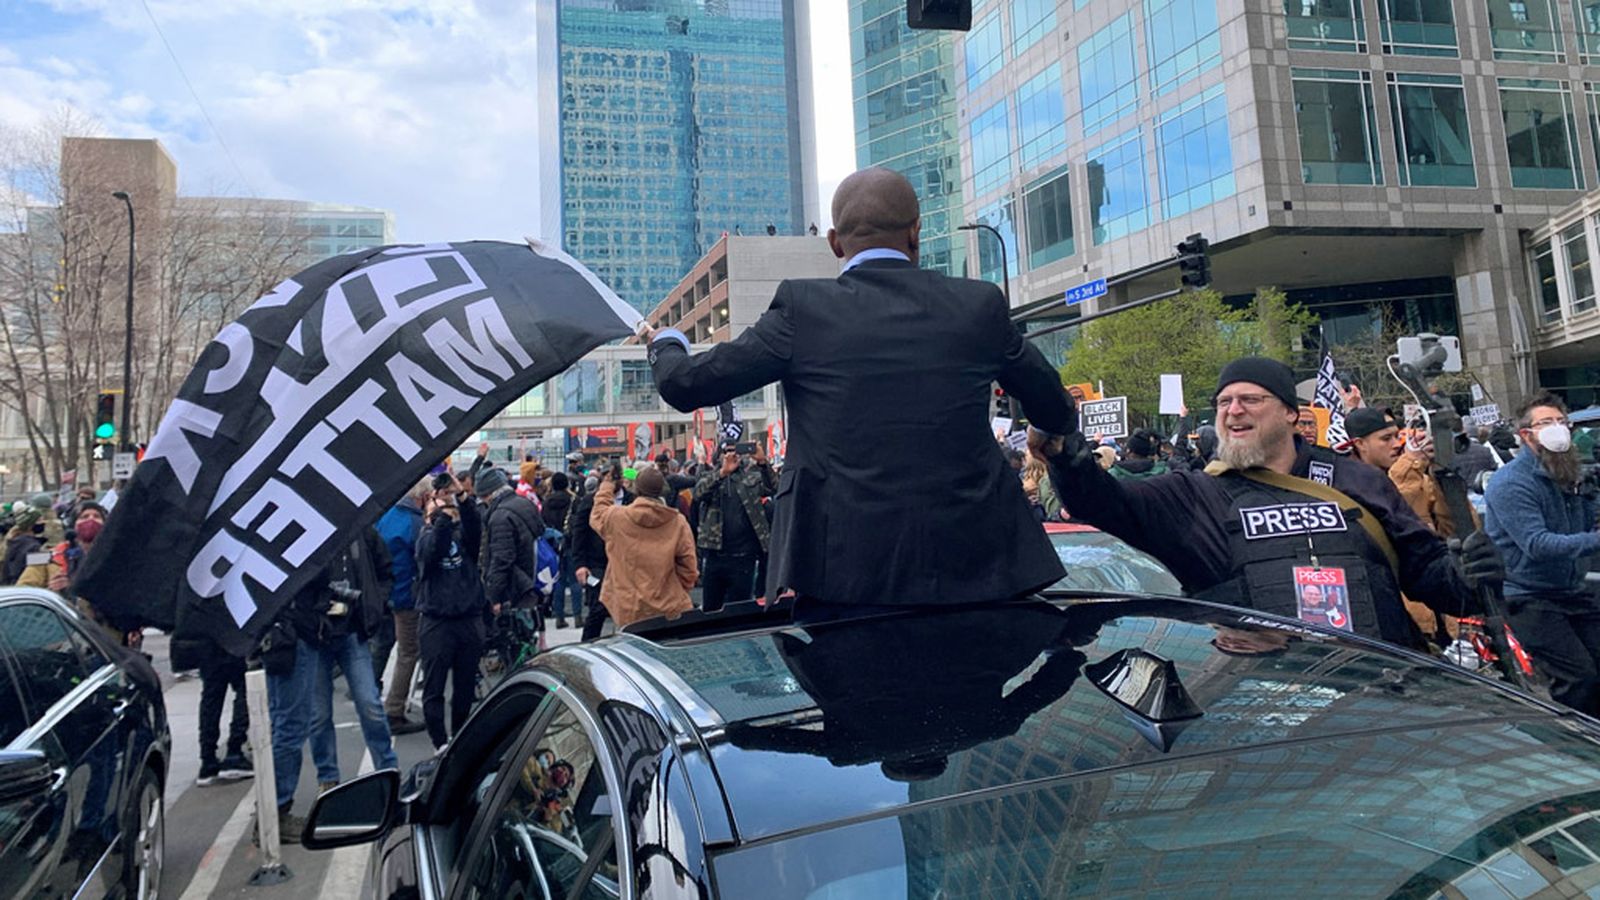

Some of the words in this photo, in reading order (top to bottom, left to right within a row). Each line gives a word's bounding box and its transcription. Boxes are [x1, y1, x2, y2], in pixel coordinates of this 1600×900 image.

[1085, 402, 1119, 413] BLACK
[1088, 413, 1118, 425] LIVES
[1085, 424, 1120, 435] MATTER
[1246, 506, 1338, 535] PRESS
[1298, 571, 1337, 583] PRESS
